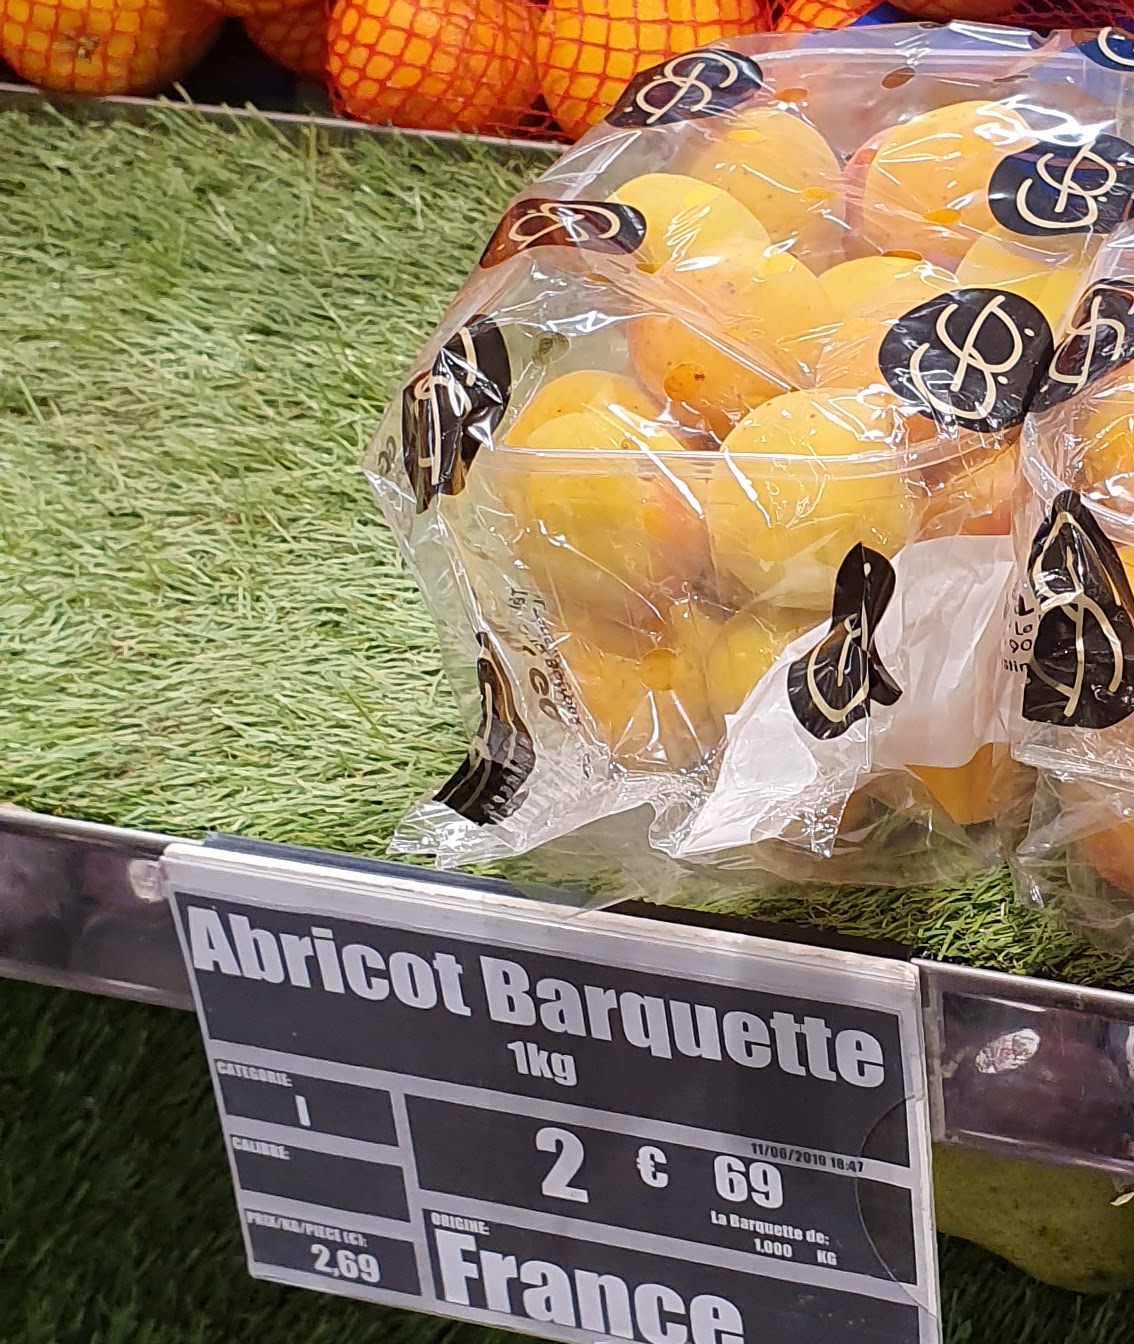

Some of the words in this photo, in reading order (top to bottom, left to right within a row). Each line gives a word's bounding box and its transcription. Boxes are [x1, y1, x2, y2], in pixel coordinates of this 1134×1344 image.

[187, 906, 471, 1017] Abricot
[480, 955, 885, 1089] Barquette
[508, 1041, 577, 1087] 1kg
[535, 1126, 589, 1204] 2
[635, 1145, 669, 1189] €
[713, 1155, 784, 1209] 69
[710, 1208, 727, 1226] La
[729, 1213, 804, 1242] Barquette
[310, 1243, 381, 1283] 2,69
[816, 1248, 838, 1266] KG
